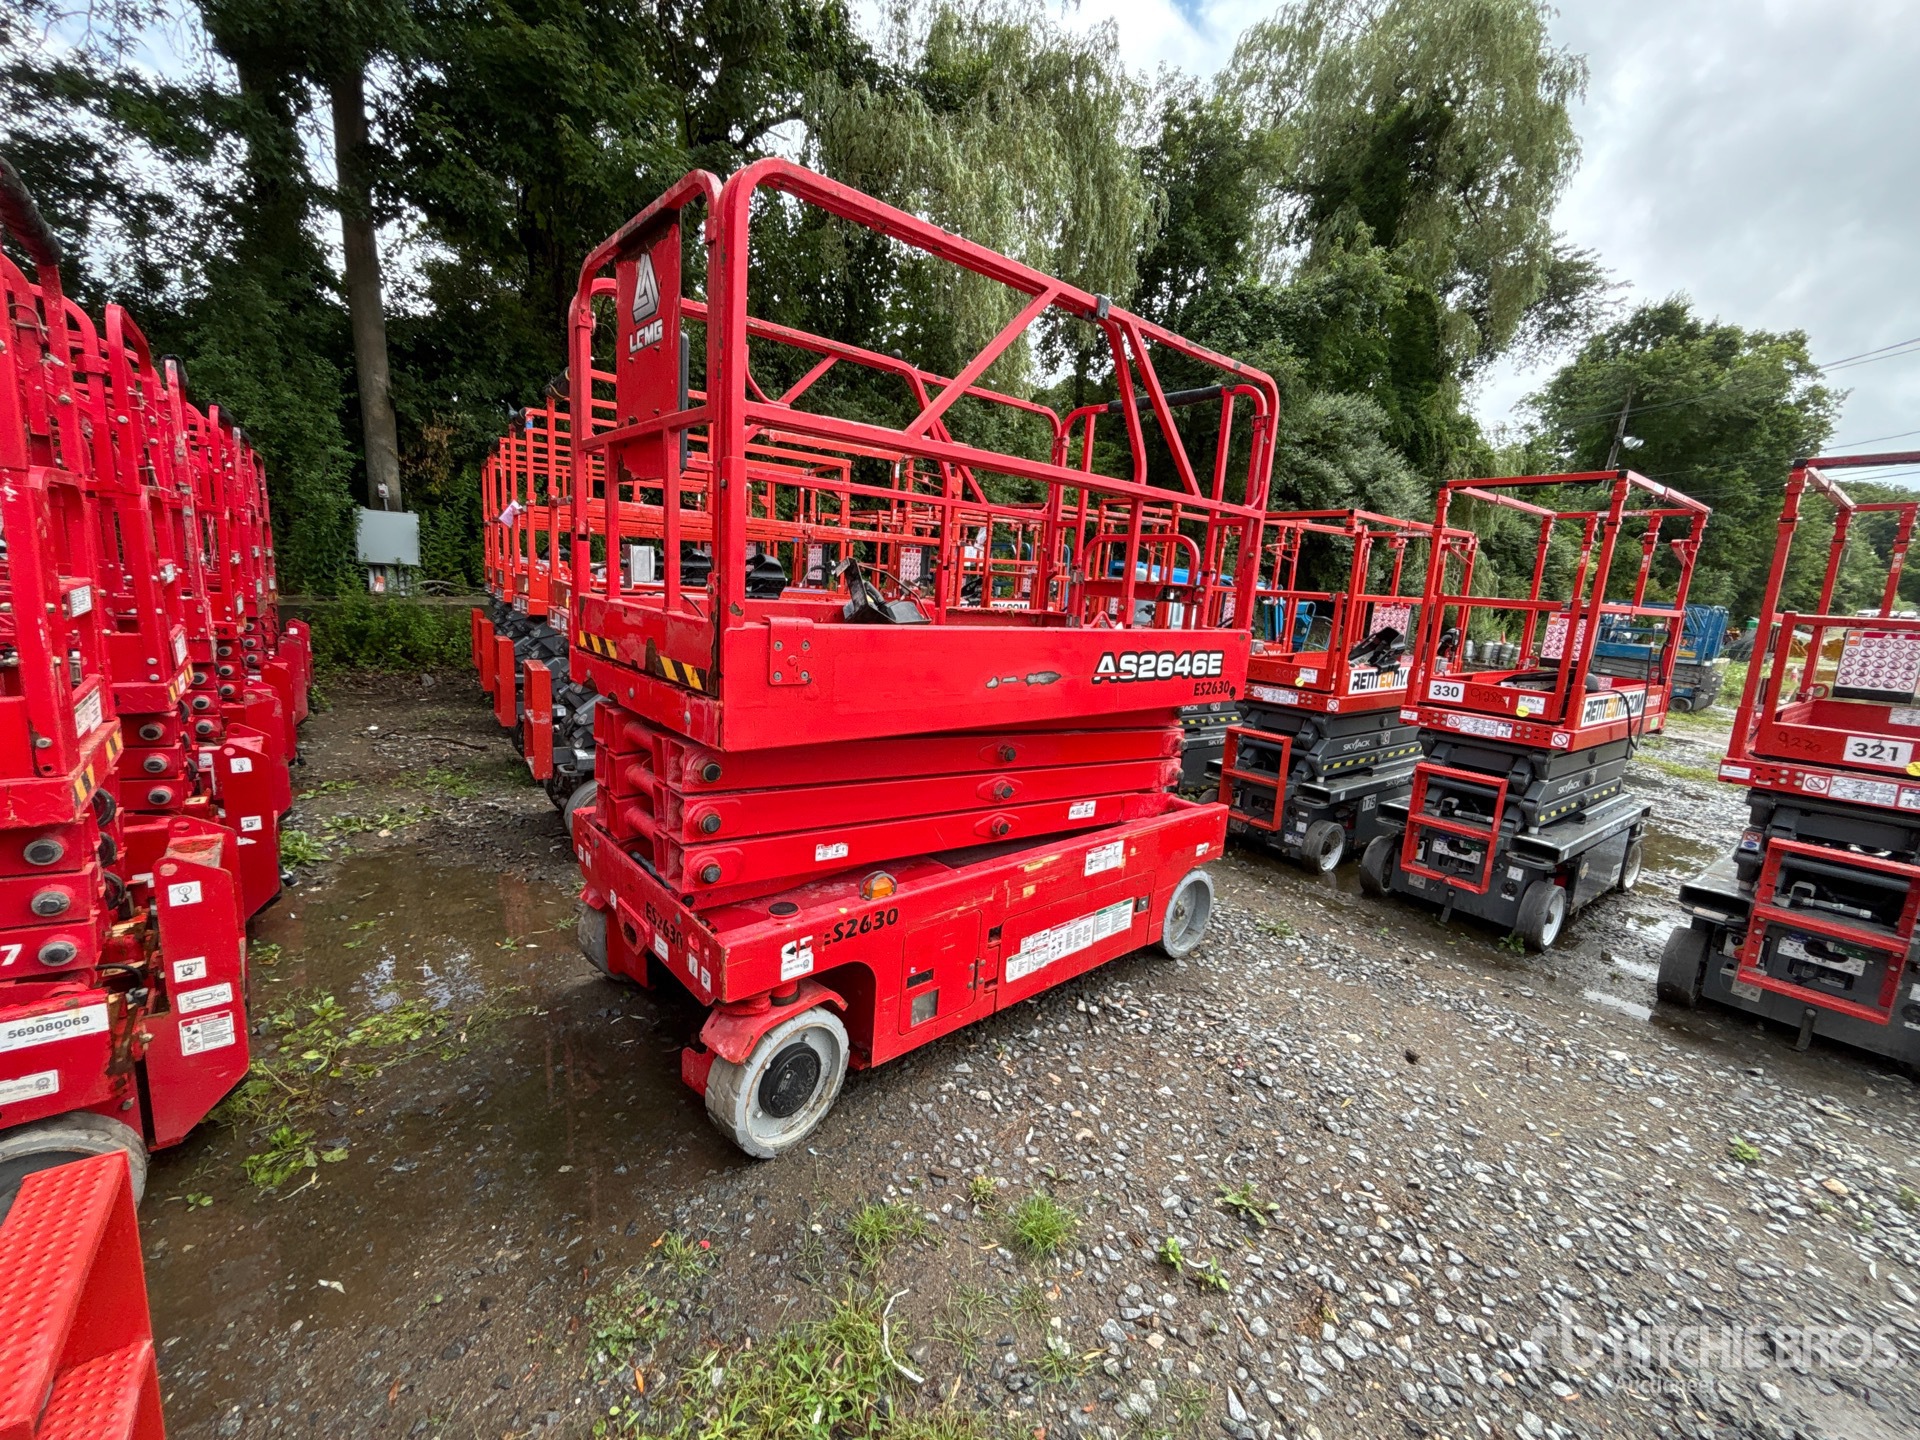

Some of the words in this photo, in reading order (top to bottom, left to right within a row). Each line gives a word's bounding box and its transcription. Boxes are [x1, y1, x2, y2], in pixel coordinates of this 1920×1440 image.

[1093, 652, 1223, 683] AS2646E
[1193, 680, 1230, 696] ES2630
[1433, 684, 1459, 698] 330
[1343, 739, 1370, 751] SKYJACK
[1852, 742, 1899, 761] 321
[8, 1015, 90, 1039] 569080069
